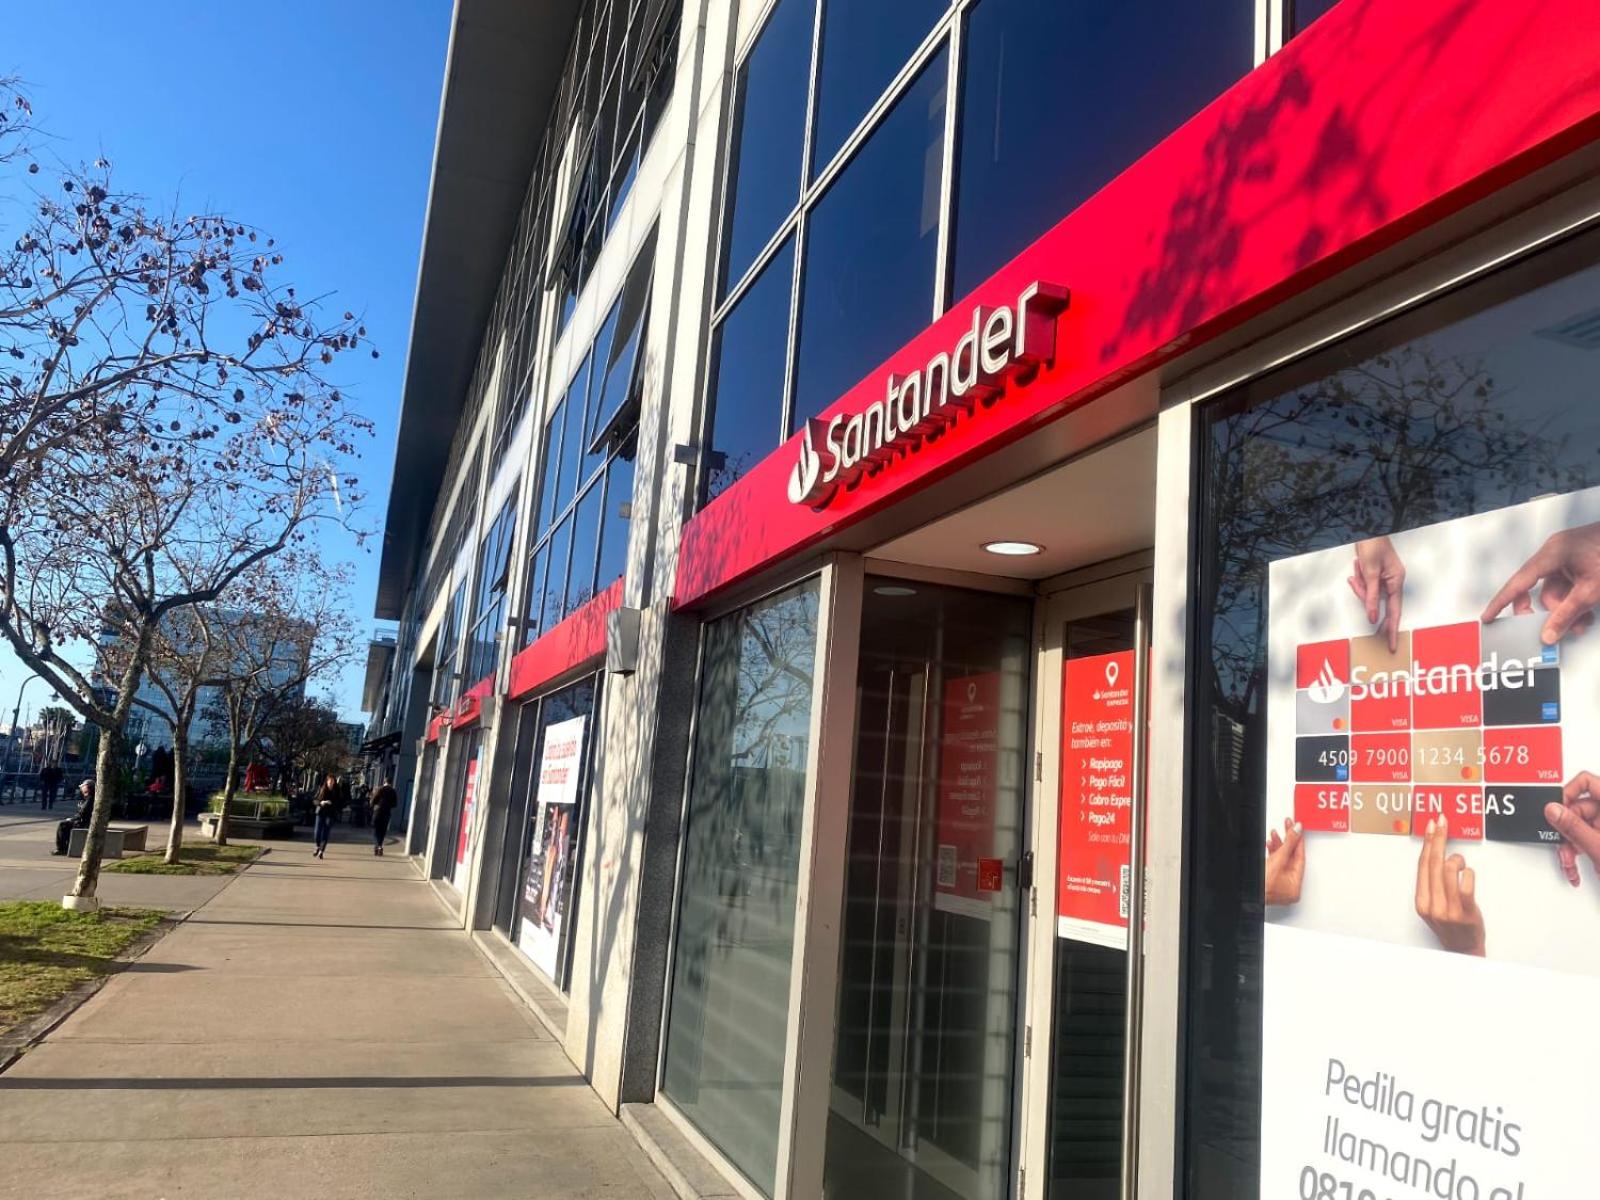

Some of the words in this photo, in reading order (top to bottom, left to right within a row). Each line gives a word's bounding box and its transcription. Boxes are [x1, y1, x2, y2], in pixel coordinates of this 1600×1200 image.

[823, 280, 1042, 483] Santander
[1350, 652, 1542, 701] Santander
[1392, 718, 1408, 726] VISA
[1460, 715, 1479, 723] VISA
[1318, 750, 1357, 766] 4509
[1366, 748, 1408, 766] 7900
[1418, 747, 1464, 765] 1234
[1476, 745, 1530, 765] 5678
[1392, 771, 1408, 780] VISA
[1537, 770, 1559, 779] VISA
[1317, 790, 1364, 811] SEAS
[1376, 792, 1442, 814] QUIEN
[1456, 793, 1516, 816] SEAS
[1332, 821, 1347, 830] VISA
[1461, 827, 1480, 836] VISA
[1538, 830, 1560, 840] VISA
[1325, 1058, 1414, 1123] Pedila
[1420, 1098, 1522, 1157] gratis
[1323, 1115, 1480, 1200] llamando
